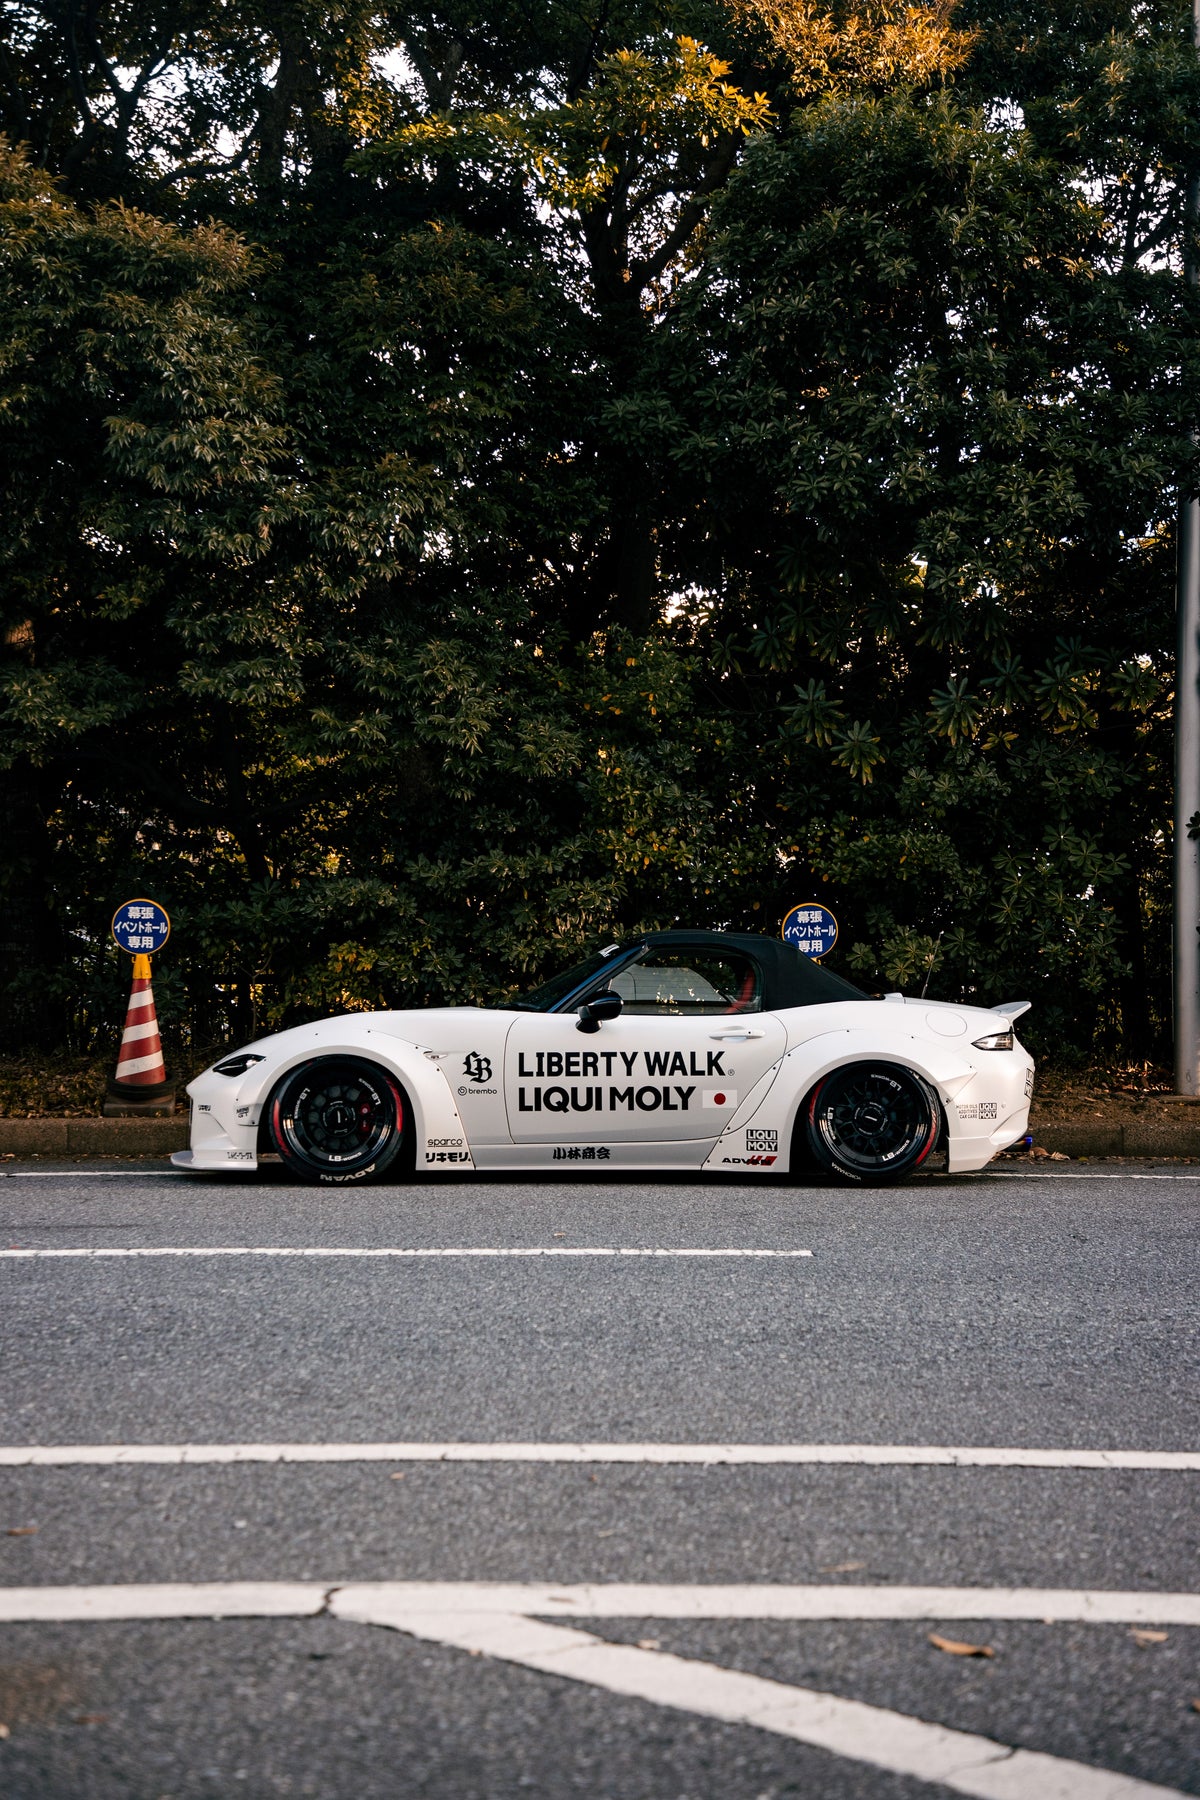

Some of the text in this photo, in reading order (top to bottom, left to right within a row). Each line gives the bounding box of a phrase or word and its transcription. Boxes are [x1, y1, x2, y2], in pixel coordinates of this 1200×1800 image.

[128, 906, 154, 919] 幕張
[797, 911, 823, 924] 幕張
[114, 921, 168, 934] イベントホール
[785, 925, 836, 939] イベントホール
[128, 936, 154, 949] 専用
[797, 940, 823, 953] 専用
[518, 1051, 726, 1077] LIBERTY WALK
[518, 1086, 697, 1113] LIQUI MOLY
[747, 1130, 777, 1141] LIQUI
[427, 1138, 464, 1148] sparco
[747, 1142, 777, 1151] MOLY
[426, 1152, 469, 1163] リキモリ
[552, 1146, 611, 1160] 小林商会
[320, 1162, 377, 1181] ADVAN
